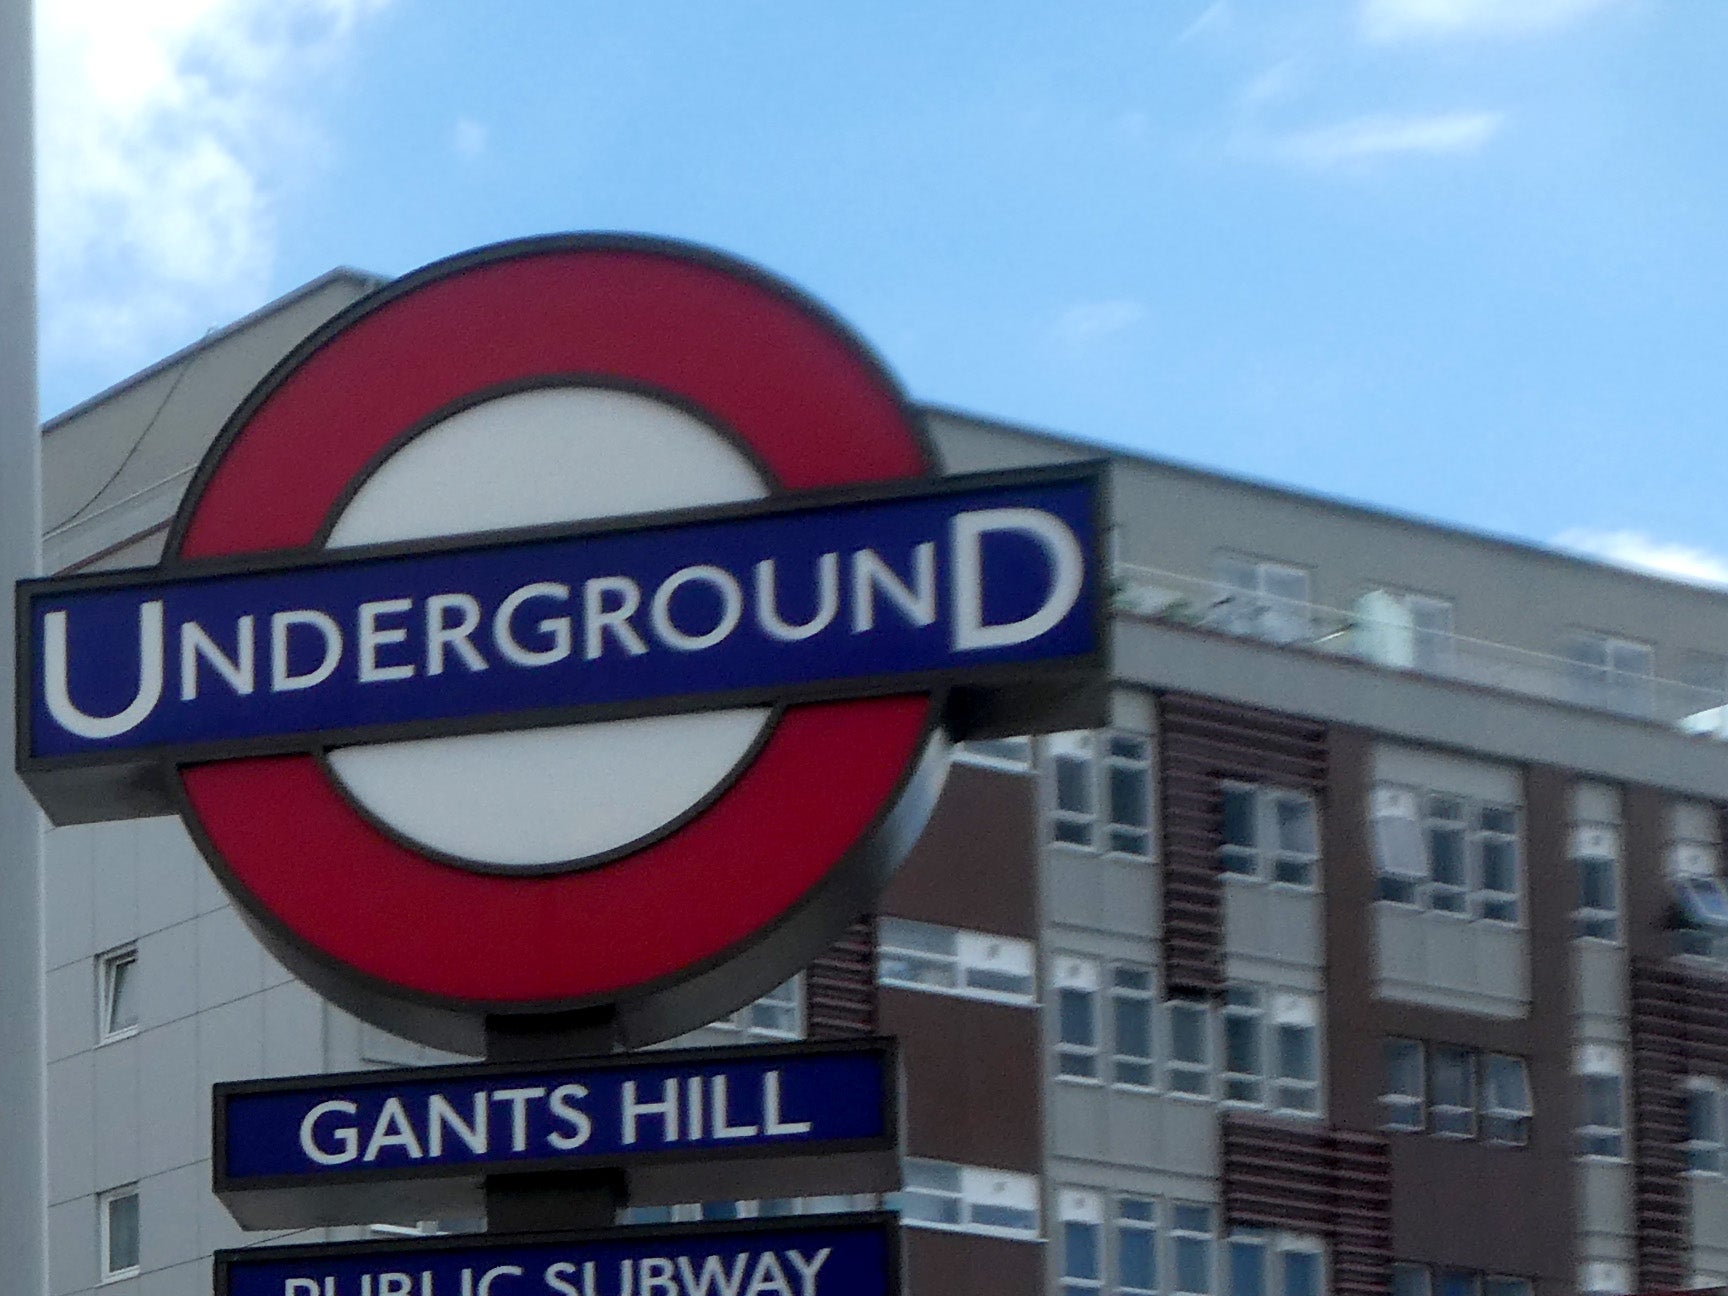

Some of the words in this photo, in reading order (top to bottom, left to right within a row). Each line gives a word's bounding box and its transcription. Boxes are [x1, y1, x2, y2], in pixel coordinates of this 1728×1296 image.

[42, 507, 1085, 740] UNDERGROUND
[299, 1083, 592, 1166] GANTS
[619, 1069, 814, 1147] HILL
